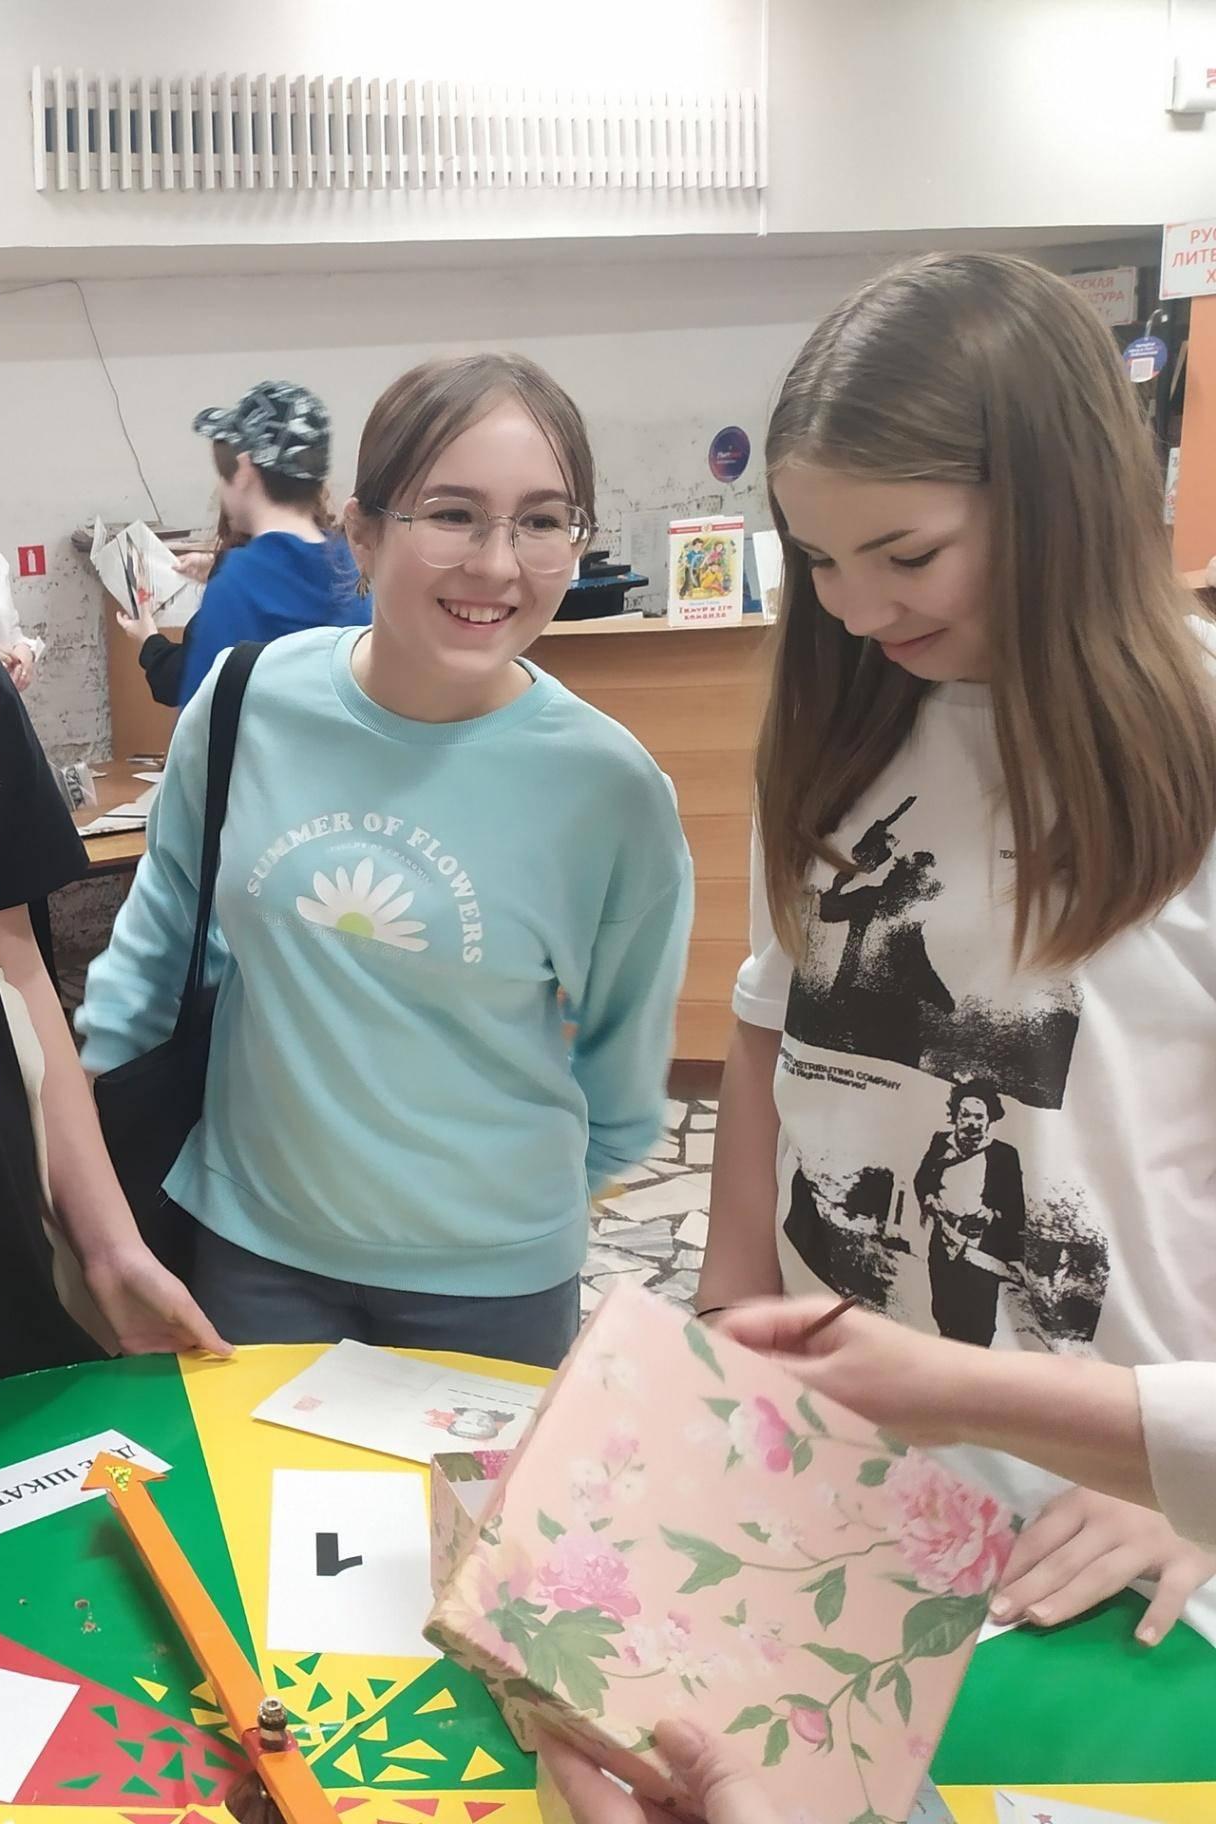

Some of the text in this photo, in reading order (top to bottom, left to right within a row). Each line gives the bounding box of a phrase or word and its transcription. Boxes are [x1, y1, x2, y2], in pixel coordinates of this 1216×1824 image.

[247, 812, 353, 897] SUMMER
[363, 812, 404, 836] OF
[406, 827, 483, 964] FLOWERS
[796, 1068, 825, 1080] Rights
[856, 1070, 901, 1090] COMPANY
[316, 1532, 363, 1576] 1
